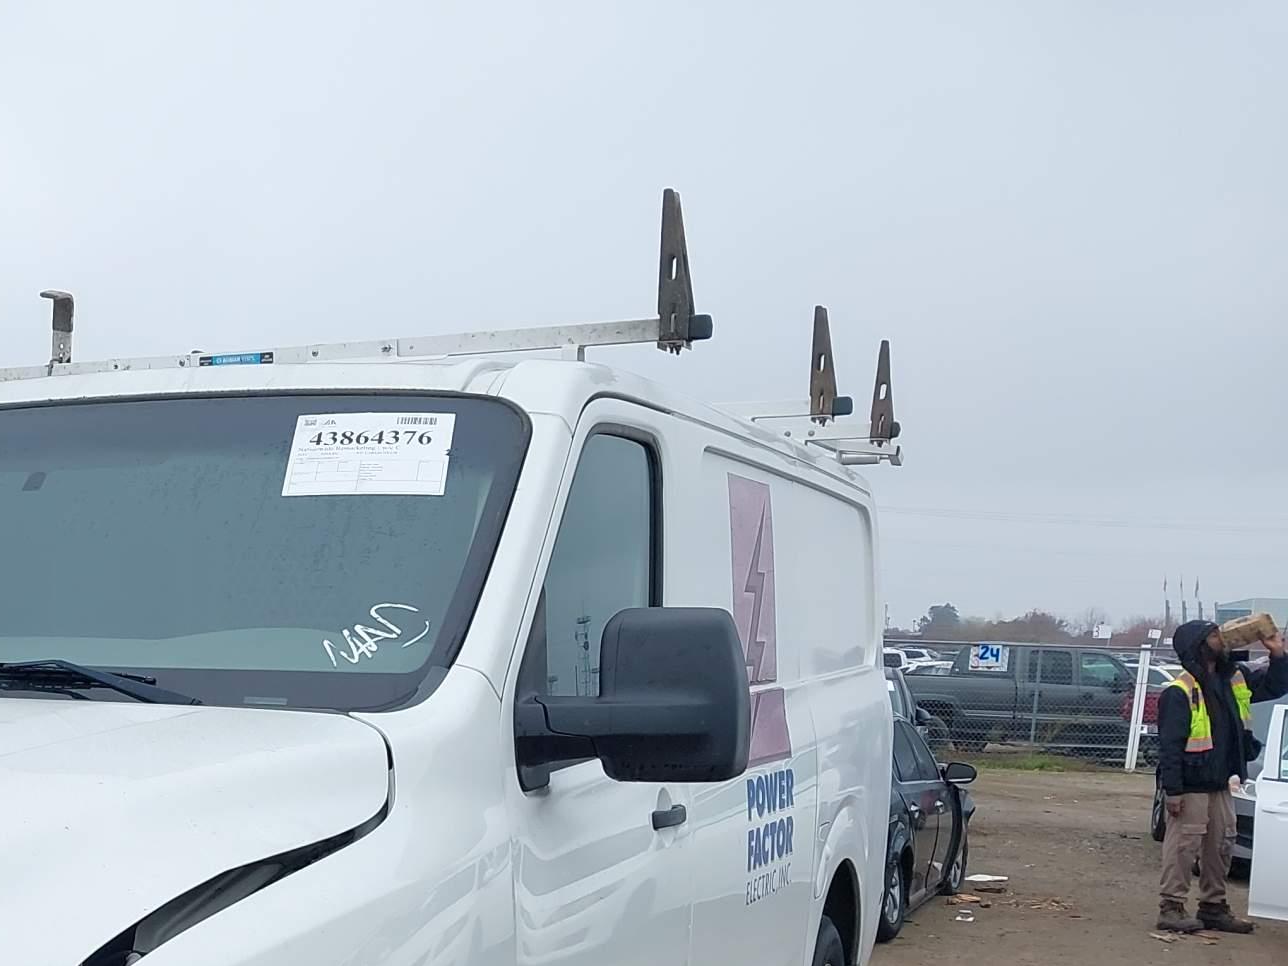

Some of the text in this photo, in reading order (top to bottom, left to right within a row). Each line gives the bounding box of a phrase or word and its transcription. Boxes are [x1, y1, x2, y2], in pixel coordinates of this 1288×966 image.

[309, 430, 434, 446] 43864376
[979, 645, 1001, 663] 24
[746, 769, 795, 821] POWER
[747, 815, 793, 872] FACTOR
[778, 862, 792, 889] INC.
